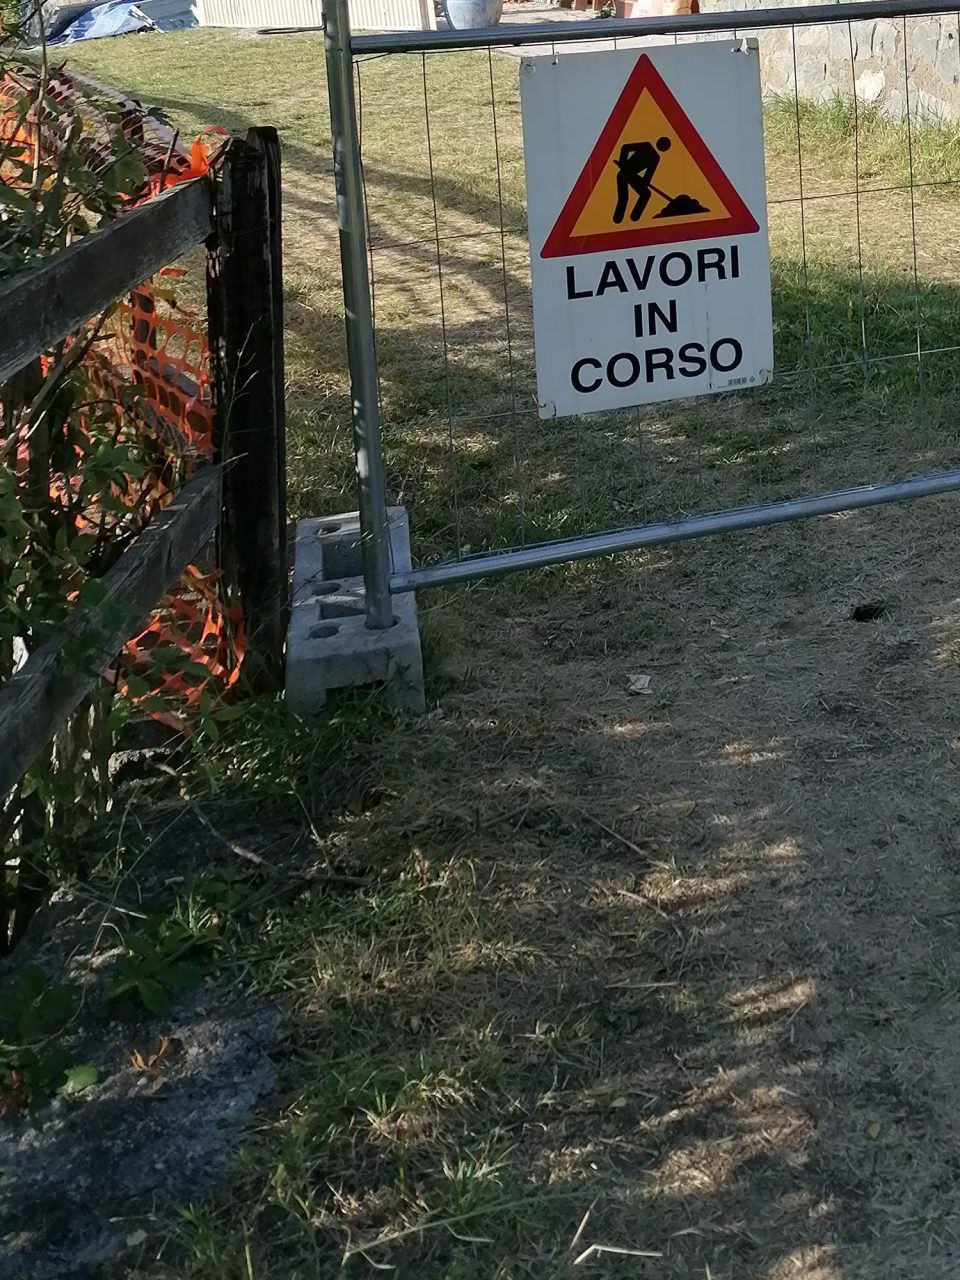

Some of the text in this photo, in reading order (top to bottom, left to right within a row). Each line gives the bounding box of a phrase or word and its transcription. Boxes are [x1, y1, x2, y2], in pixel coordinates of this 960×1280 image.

[566, 245, 740, 300] LAVORI
[634, 299, 678, 338] IN
[570, 337, 743, 394] CORSO
